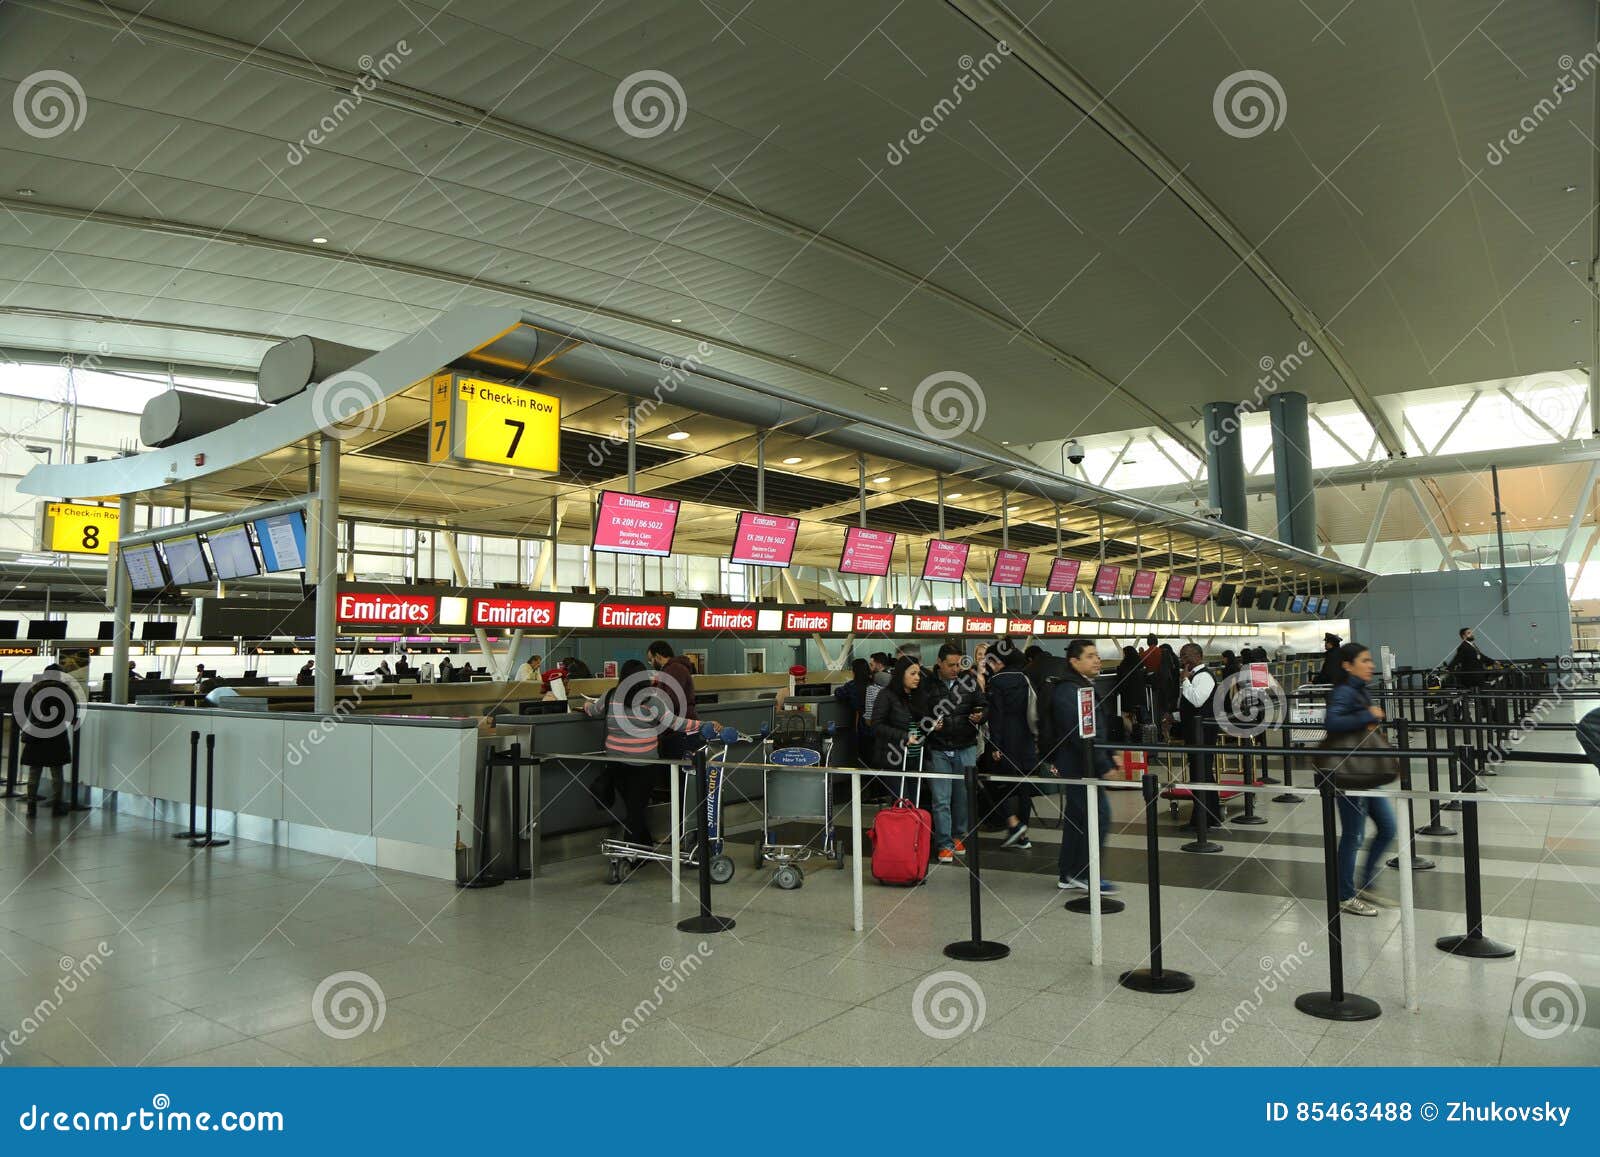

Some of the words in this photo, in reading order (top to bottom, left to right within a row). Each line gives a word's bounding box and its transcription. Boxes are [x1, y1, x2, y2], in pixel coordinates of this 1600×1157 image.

[480, 388, 527, 407] Check-in
[530, 399, 553, 413] Row
[435, 420, 447, 452] 7
[504, 418, 525, 459] 7
[619, 497, 650, 509] Emirates
[64, 507, 102, 518] Check-in
[753, 516, 777, 527] Emirates
[82, 525, 100, 549] 8
[340, 596, 429, 621] Emirates
[477, 602, 550, 624] Emirates
[602, 606, 661, 627] Emirates
[704, 610, 753, 629] Emirates
[787, 613, 828, 629] Emirates
[857, 616, 892, 631] Emirates
[915, 617, 945, 631] Emirates
[966, 619, 992, 632] Emirates
[1046, 621, 1068, 632] Emirates
